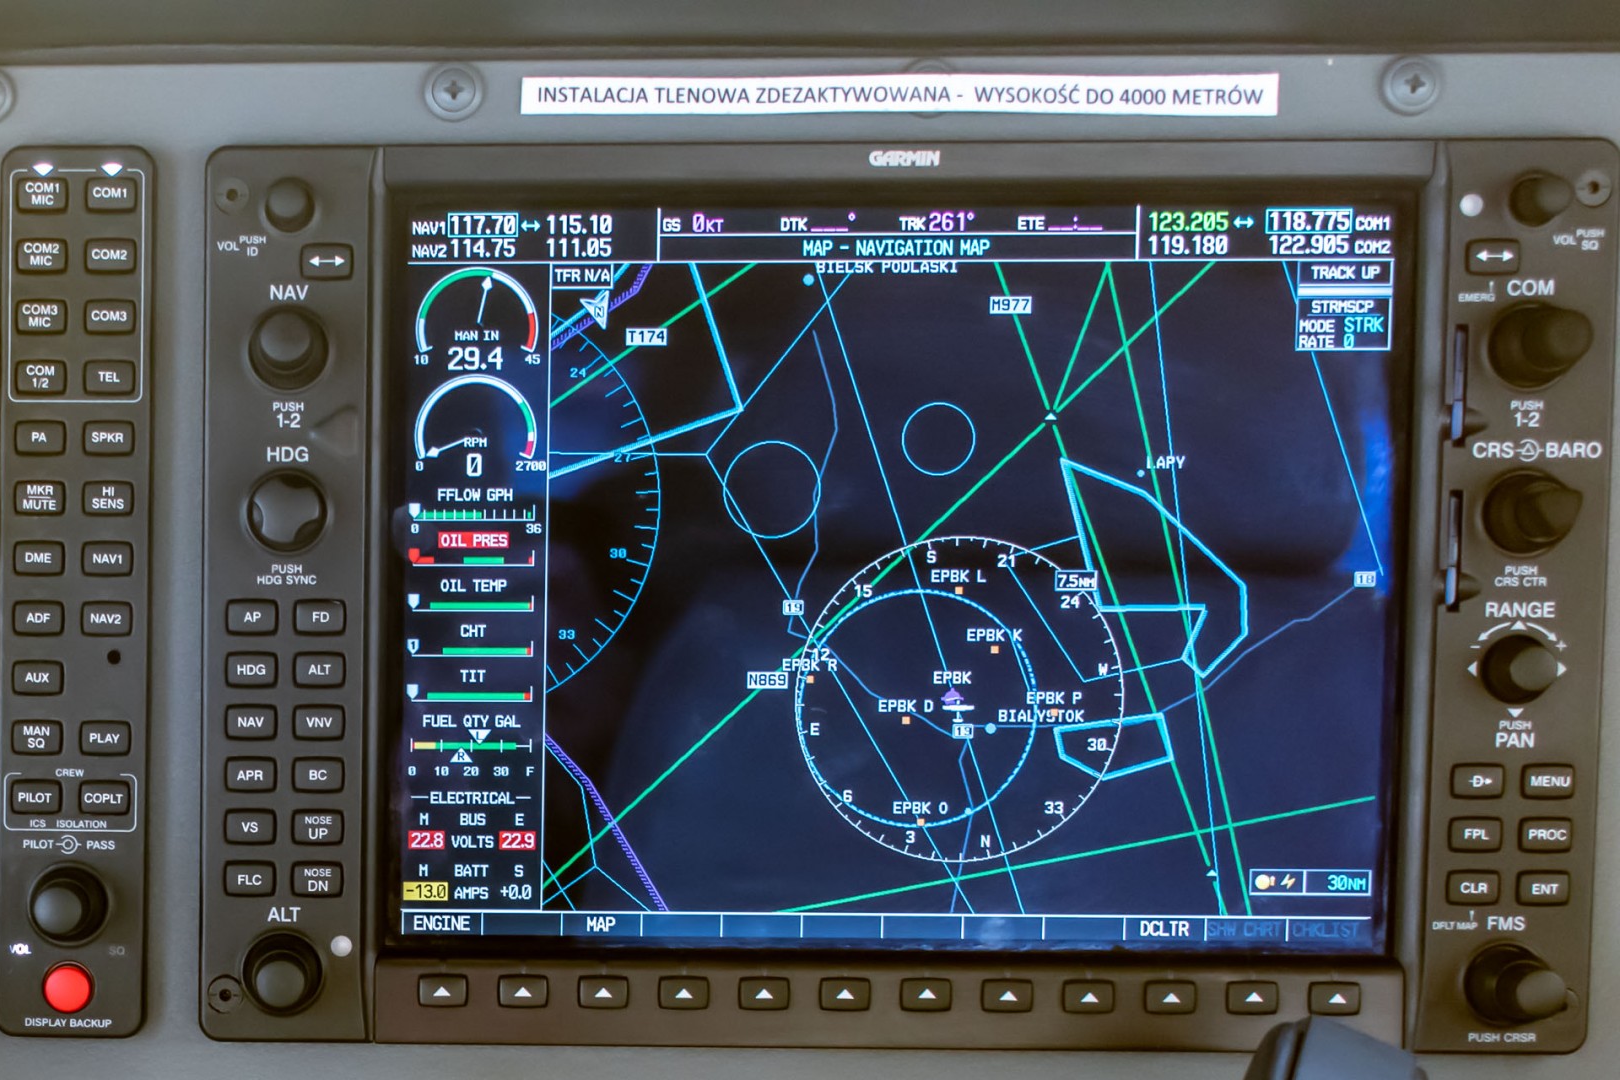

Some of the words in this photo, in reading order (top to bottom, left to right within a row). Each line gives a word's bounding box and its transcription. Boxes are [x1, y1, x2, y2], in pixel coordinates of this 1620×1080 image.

[538, 86, 648, 104] INSTALACJA
[654, 86, 750, 104] TLENOWA
[756, 86, 951, 103] ZDEZAKTYWOWANA
[975, 83, 1081, 104] WYSOKOŚĆ
[1086, 88, 1115, 105] DO
[1120, 88, 1167, 105] 4000
[1172, 84, 1264, 106] METRÓW
[869, 150, 940, 166] GARMIN
[26, 182, 60, 194] COM1
[93, 187, 127, 199] COM1
[412, 220, 446, 235] NAV1
[451, 215, 515, 234] 117.70
[546, 215, 612, 234] 115.10
[803, 240, 833, 256] MAP
[856, 240, 954, 256] NAVIGATION
[960, 239, 991, 256] MAP
[1311, 301, 1374, 314] STRMSCP
[628, 329, 665, 343] T174
[448, 348, 503, 370] 29.4
[99, 372, 120, 382] TEL
[92, 432, 124, 443] SPKR
[438, 489, 481, 501] FFLOW
[487, 489, 513, 501] GPH
[441, 534, 468, 547] OIL
[473, 534, 508, 547] PRES
[92, 553, 122, 564] NAV1
[1485, 602, 1555, 618] RANGE
[749, 673, 786, 687] N869
[423, 715, 457, 728] FUEL
[464, 715, 489, 728] QTY
[495, 715, 521, 728] GAL
[998, 710, 1084, 723] BIALYSTOK
[89, 732, 119, 744] PLAY
[56, 769, 84, 778] CREW
[84, 792, 123, 805] COPLT
[430, 791, 515, 805] ELECTRICAL
[30, 819, 46, 828] ICS
[56, 819, 107, 829] ISOLATION
[23, 839, 53, 850] PILOT
[86, 839, 115, 850] PASS
[411, 833, 443, 848] 22.8
[452, 835, 494, 849] VOLTS
[502, 833, 534, 848] 22.9
[1327, 875, 1366, 891] 30NM
[413, 916, 470, 931] ENGINE
[1140, 921, 1189, 937] DCLTR
[25, 1018, 67, 1028] DISPLAY
[69, 1018, 112, 1028] BACKUP
